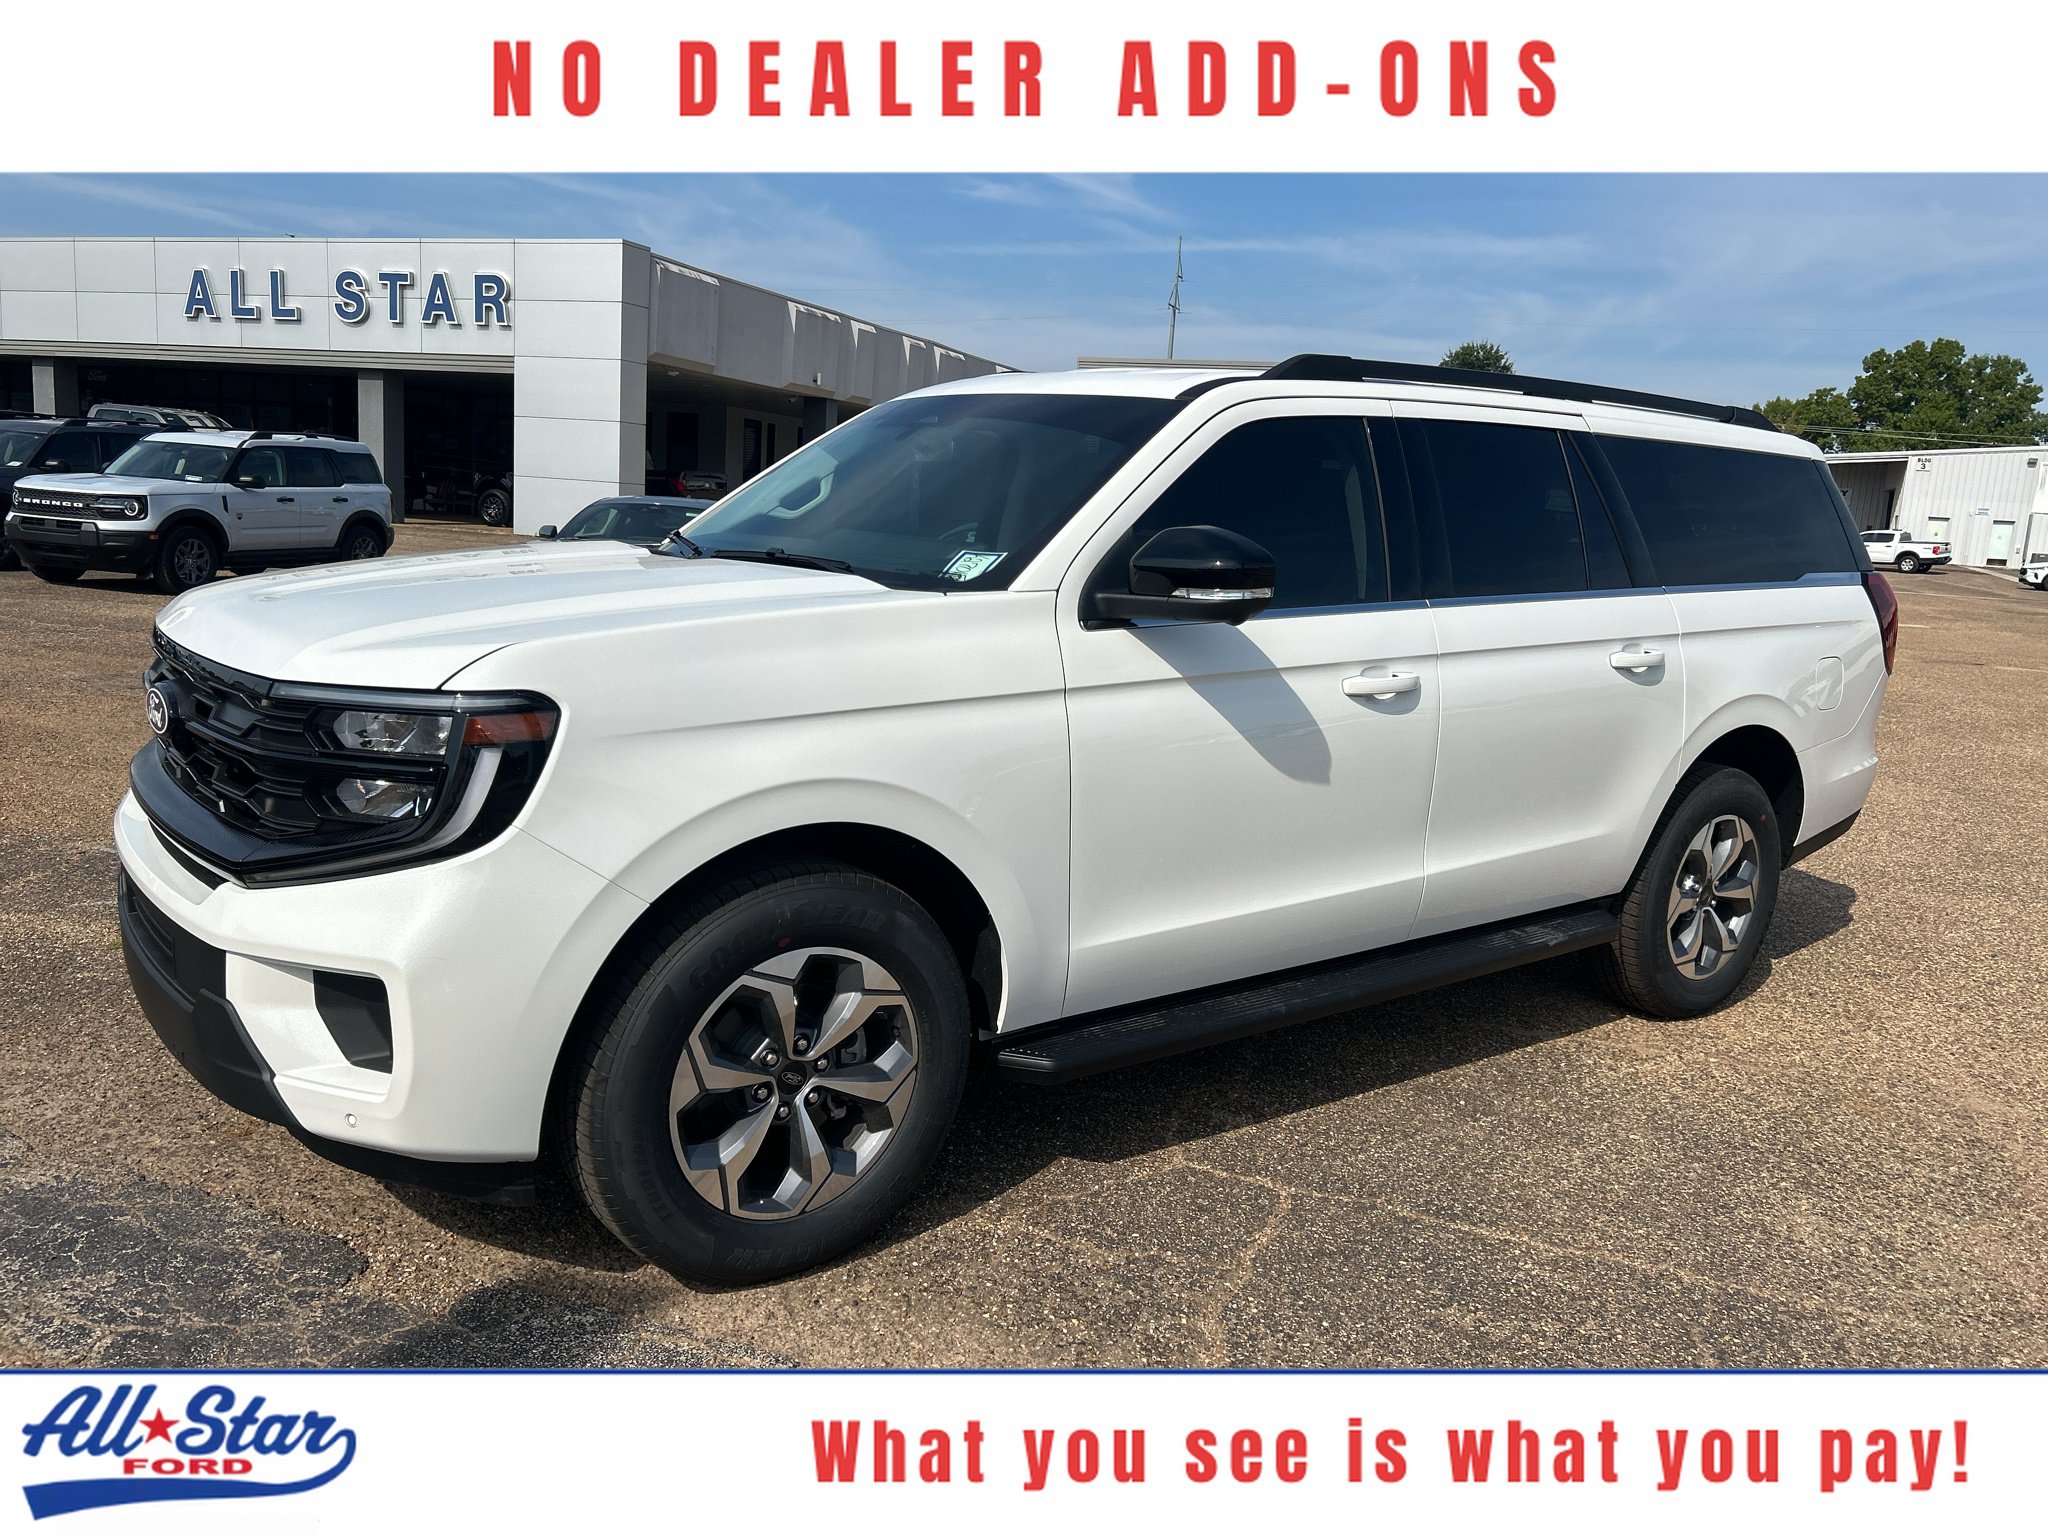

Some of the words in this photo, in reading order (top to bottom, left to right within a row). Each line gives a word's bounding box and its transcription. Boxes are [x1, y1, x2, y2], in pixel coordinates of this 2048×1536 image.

[183, 267, 302, 322] ALL
[333, 269, 512, 326] STAR
[22, 498, 83, 507] BRONCO
[149, 692, 163, 728] Ford
